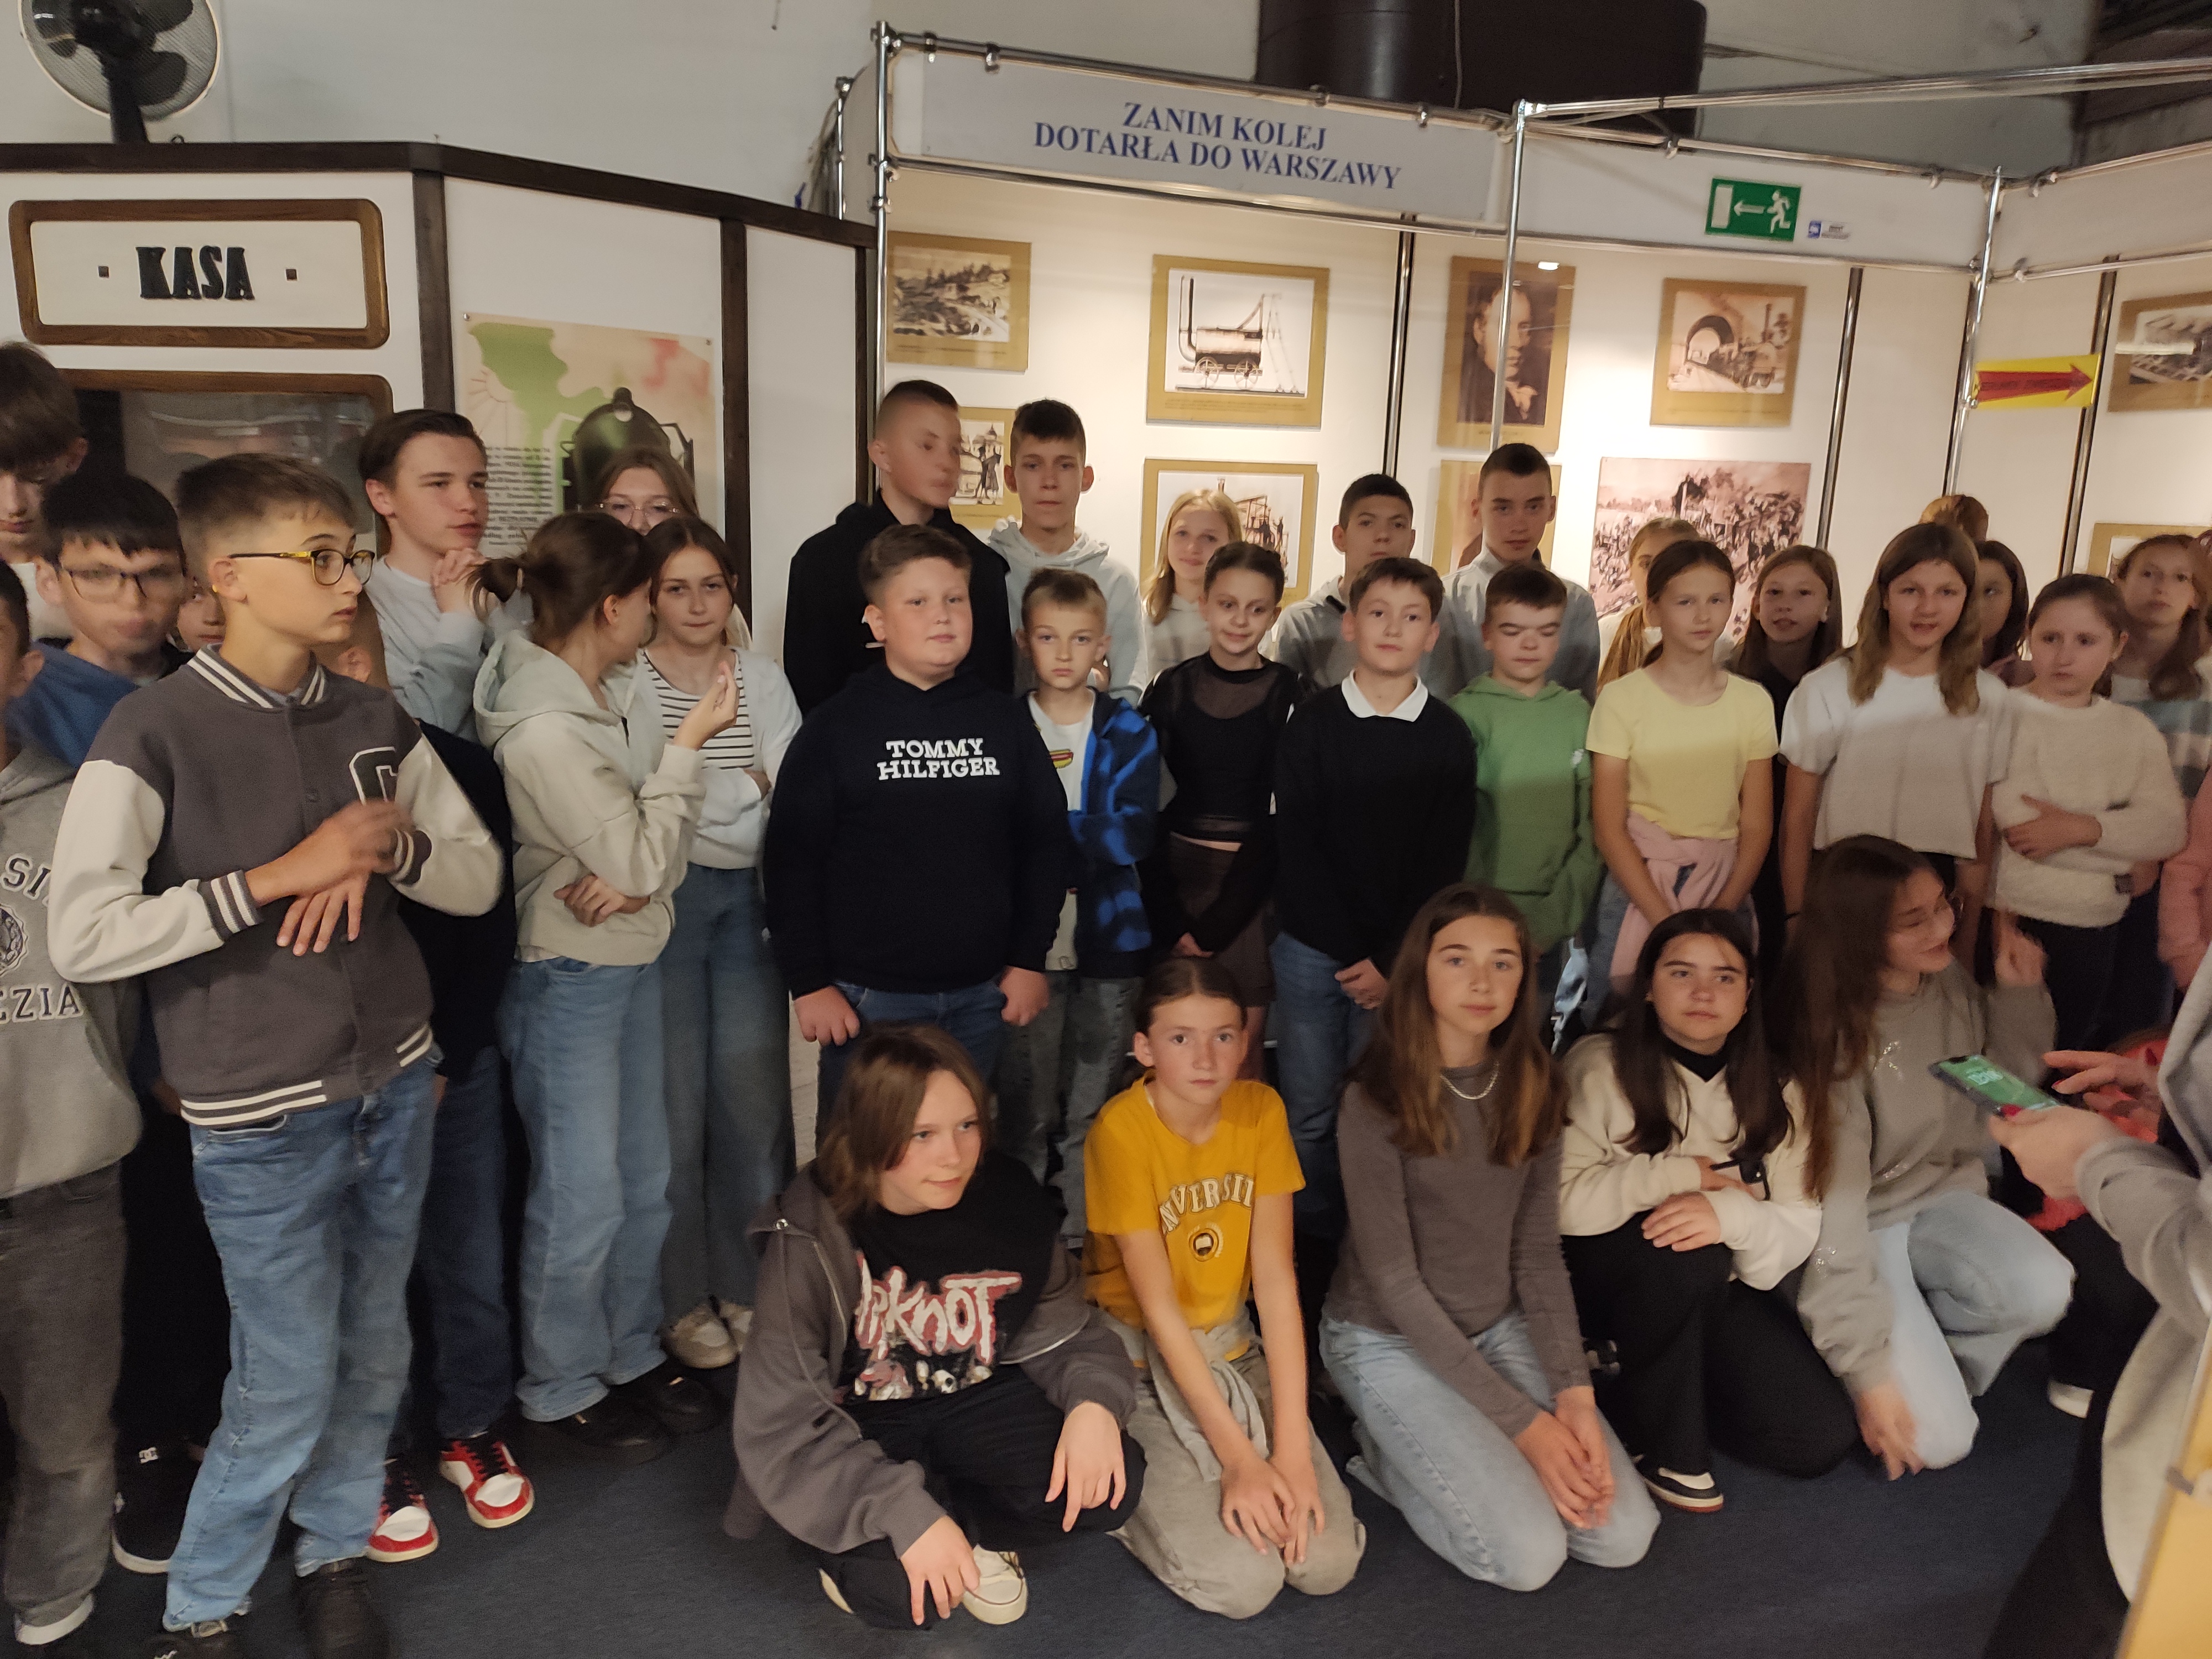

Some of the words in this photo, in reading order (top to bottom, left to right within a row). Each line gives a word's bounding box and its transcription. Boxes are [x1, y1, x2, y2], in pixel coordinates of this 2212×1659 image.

[1123, 102, 1222, 138] ZANIM
[1232, 116, 1328, 153] KOLEJ
[1034, 122, 1180, 165] DOTARŁA
[1189, 141, 1232, 170] DO
[1242, 148, 1402, 190] WARSZAWY
[135, 245, 255, 301] KASA
[877, 757, 1001, 781] HILFIGER
[885, 737, 985, 760] TOMMY
